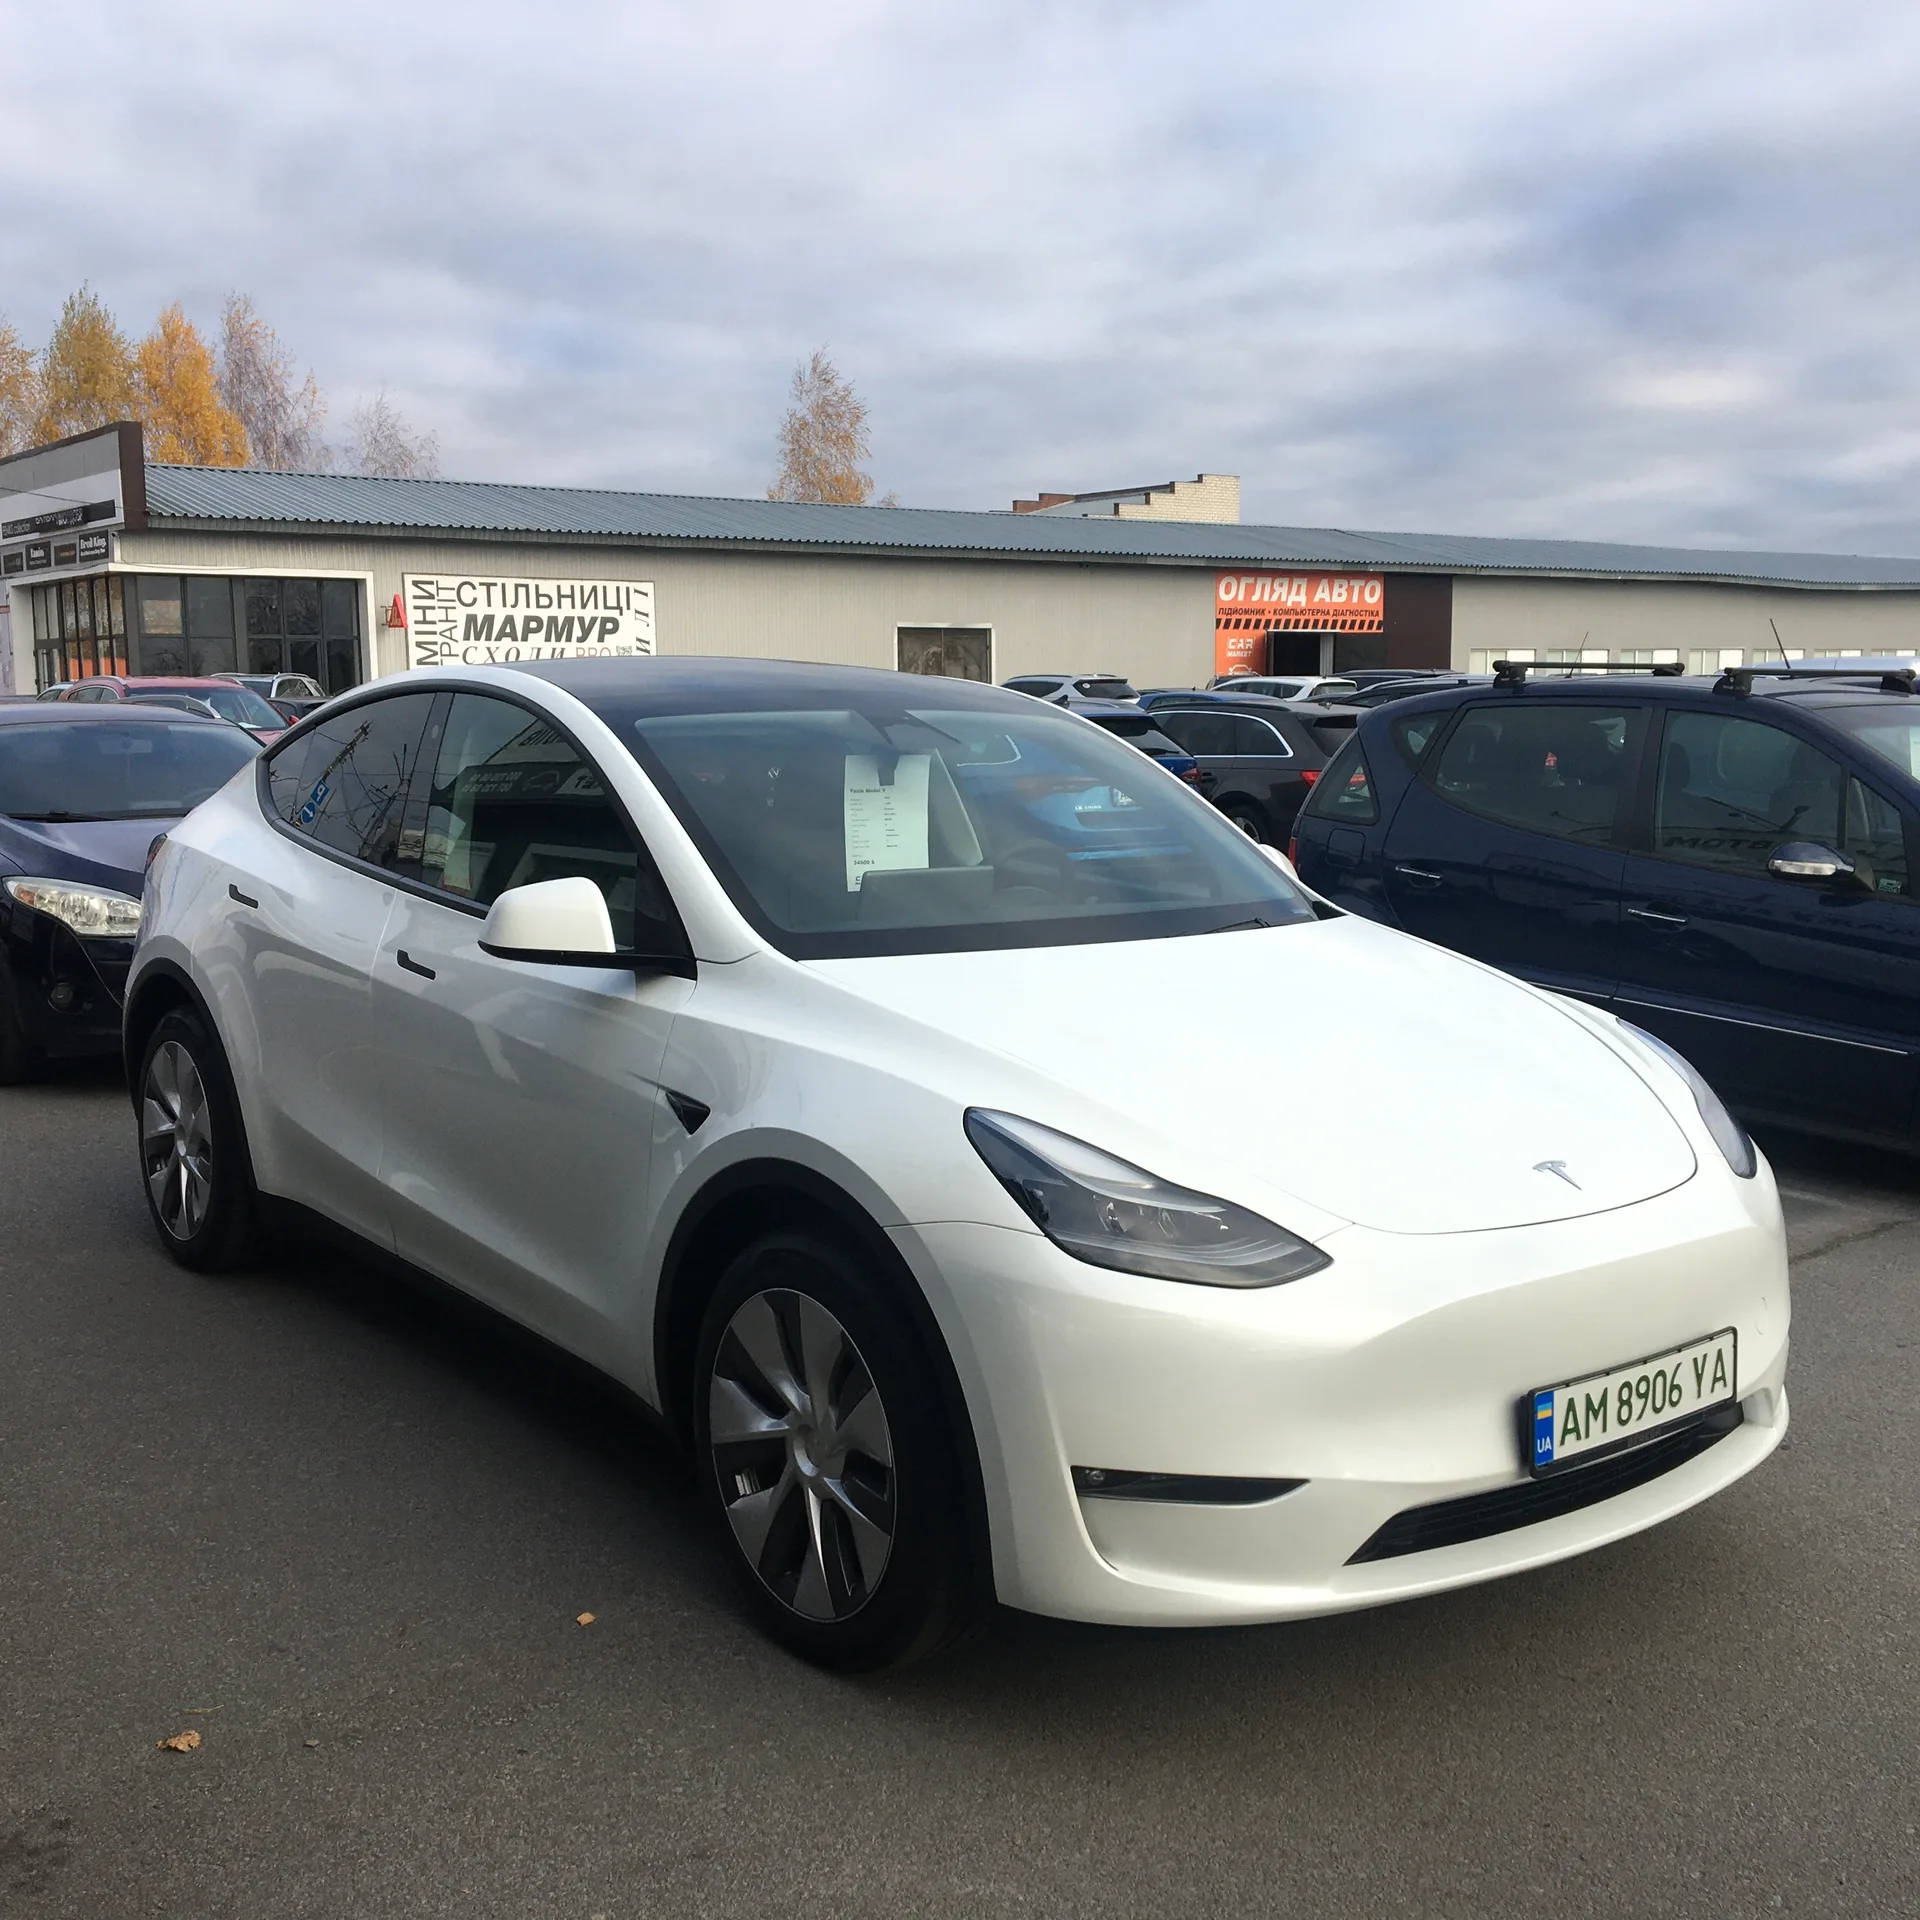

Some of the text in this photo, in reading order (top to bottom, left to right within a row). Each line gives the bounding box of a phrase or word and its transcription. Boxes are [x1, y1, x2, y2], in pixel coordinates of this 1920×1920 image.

[456, 581, 631, 616] СТІЛЬНИЦІ
[1219, 576, 1381, 607] ОГЛЯД АВТО
[436, 580, 459, 666] РАНІТ
[1218, 606, 1379, 617] ПІДЙОМНИК КОМПЬЮТЕРНА ДІАГНОСТІКА
[463, 613, 620, 643] МАРМУР
[1228, 638, 1254, 650] CAR
[1559, 1348, 1727, 1446] AM 8906 YA
[1537, 1436, 1552, 1453] UA
